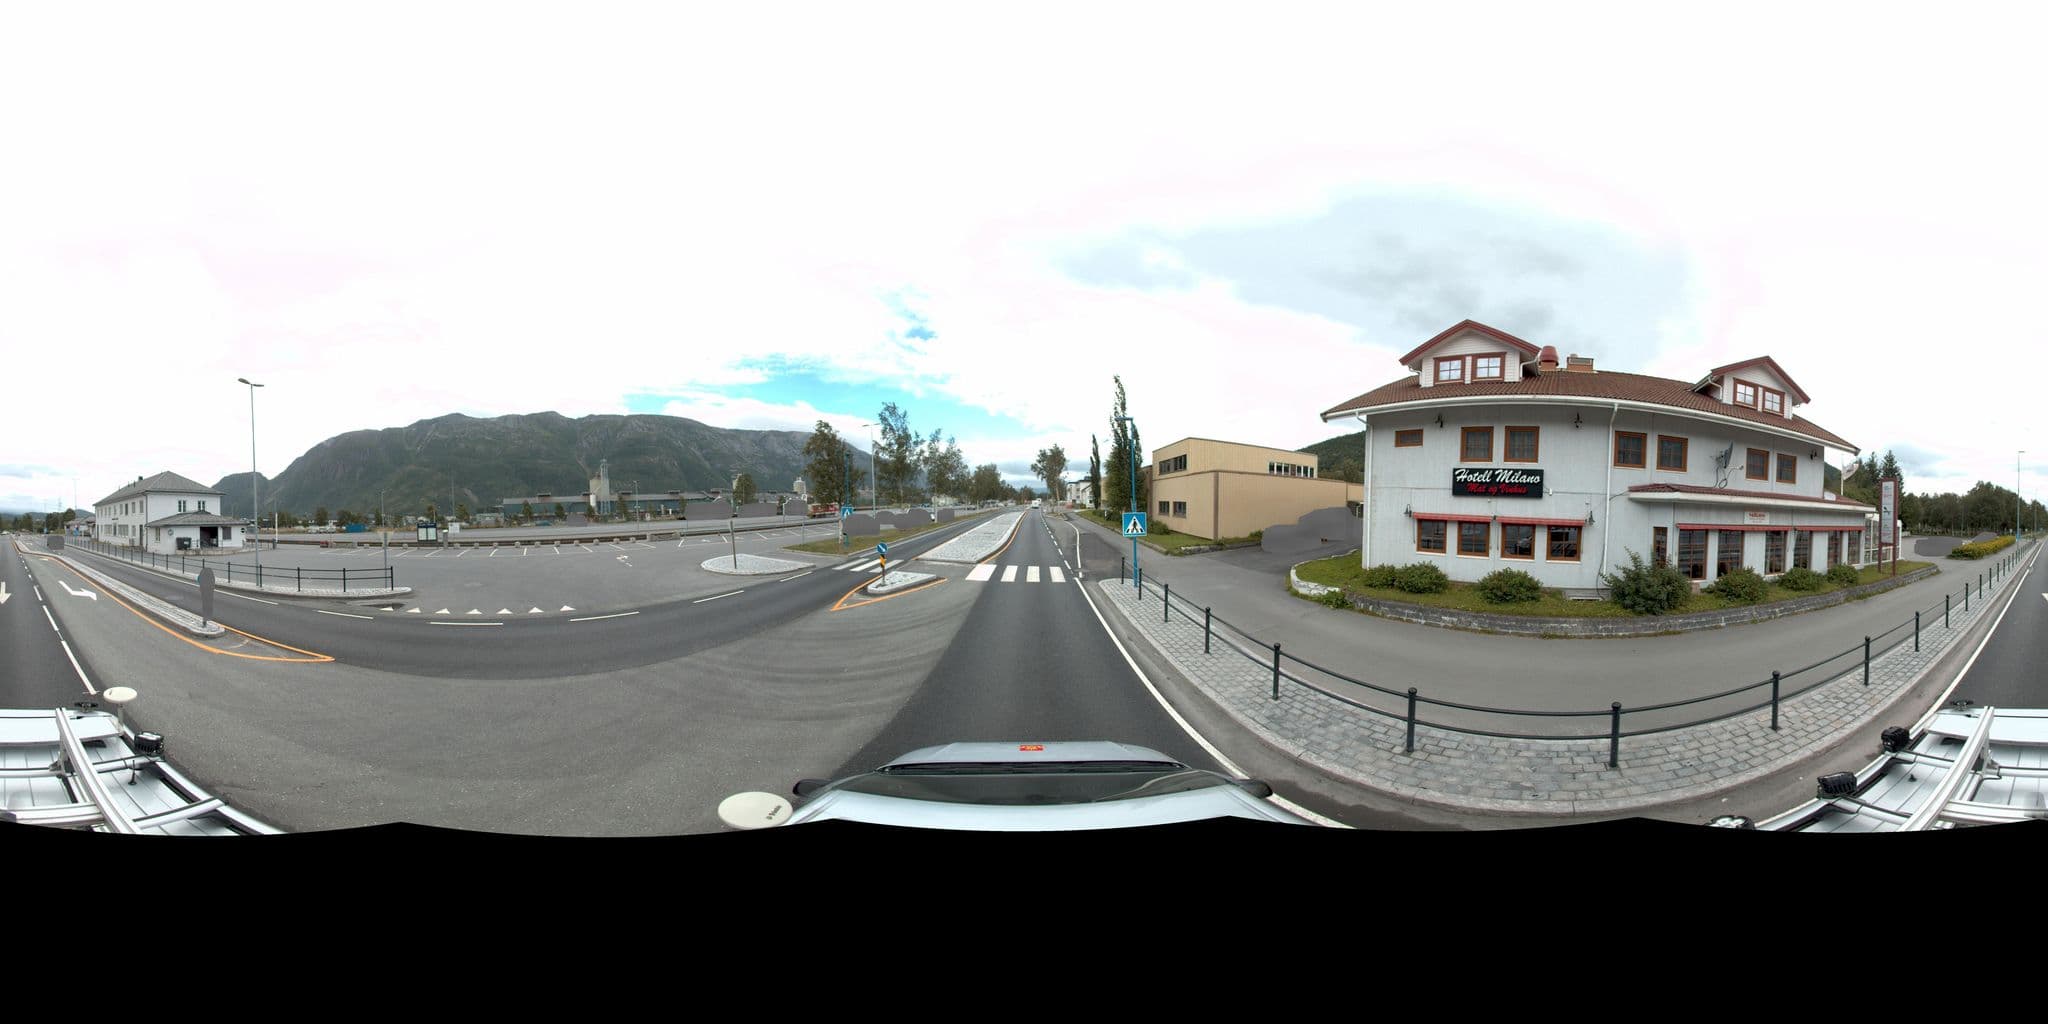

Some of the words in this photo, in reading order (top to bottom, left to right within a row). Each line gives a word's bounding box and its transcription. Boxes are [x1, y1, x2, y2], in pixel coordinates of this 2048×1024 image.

[1455, 468, 1493, 482] Hotell
[1495, 469, 1541, 483] Milano
[1466, 483, 1488, 493] Mat
[1488, 485, 1498, 495] og
